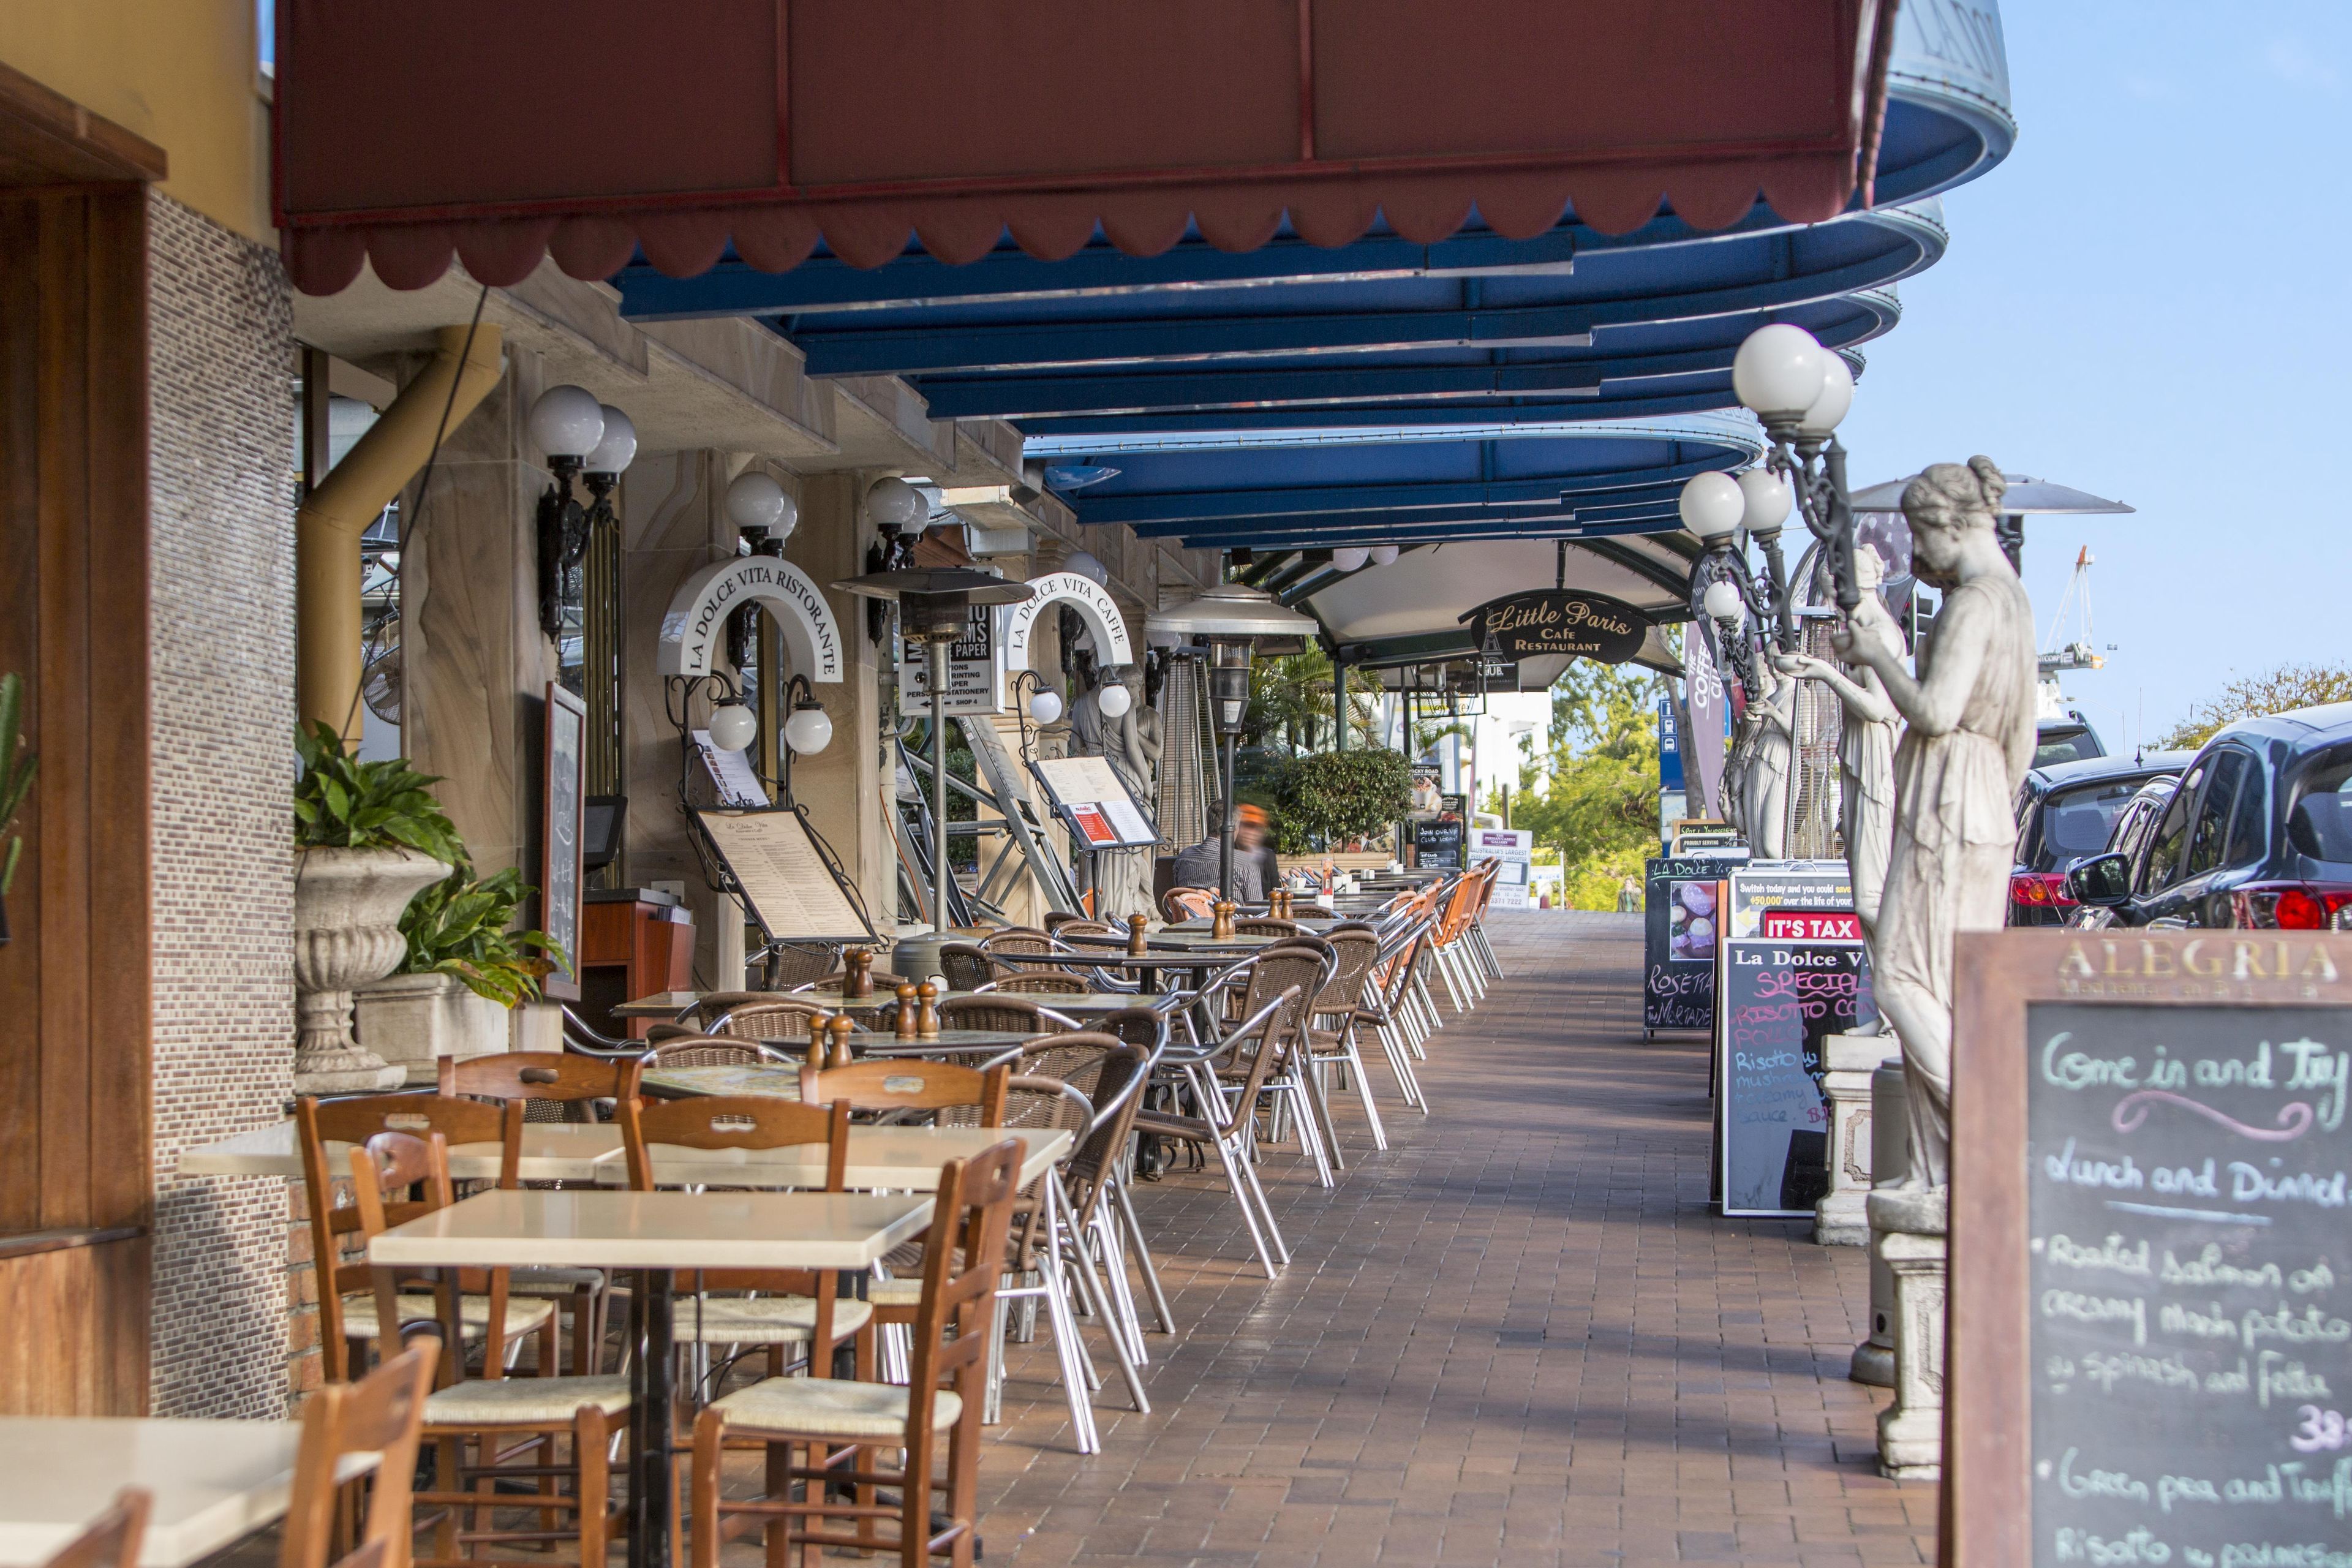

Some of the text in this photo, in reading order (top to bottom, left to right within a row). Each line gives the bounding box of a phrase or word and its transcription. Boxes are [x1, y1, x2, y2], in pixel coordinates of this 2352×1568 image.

[690, 567, 835, 674] LA DOLCE VITA RISTORANTE
[1013, 629, 1025, 649] LA
[1019, 579, 1057, 621] DOLCE
[1063, 578, 1091, 598] VITA
[1097, 598, 1125, 644] CAFFE
[1485, 600, 1632, 635] Little Paris
[956, 643, 987, 657] PAPER
[1688, 649, 1697, 676] THE
[1740, 883, 1765, 893] Switch
[1766, 884, 1786, 894] today
[1787, 884, 1801, 893] and
[1803, 886, 1815, 894] you
[1817, 884, 1833, 894] could
[1801, 896, 1812, 905] the
[1814, 895, 1825, 905] life
[1826, 895, 1834, 905] of
[1836, 897, 1852, 907] your
[1768, 920, 1853, 938] IT'S TAX
[1735, 950, 1763, 965] La
[1773, 951, 1837, 967] Dolce
[2058, 938, 2339, 982] ALEGRIA
[2042, 1031, 2139, 1090] Come
[2144, 1045, 2187, 1089] in
[2193, 1039, 2275, 1089] and
[2150, 1158, 2221, 1198] and
[2206, 1357, 2250, 1394] and
[2223, 1464, 2284, 1506] and
